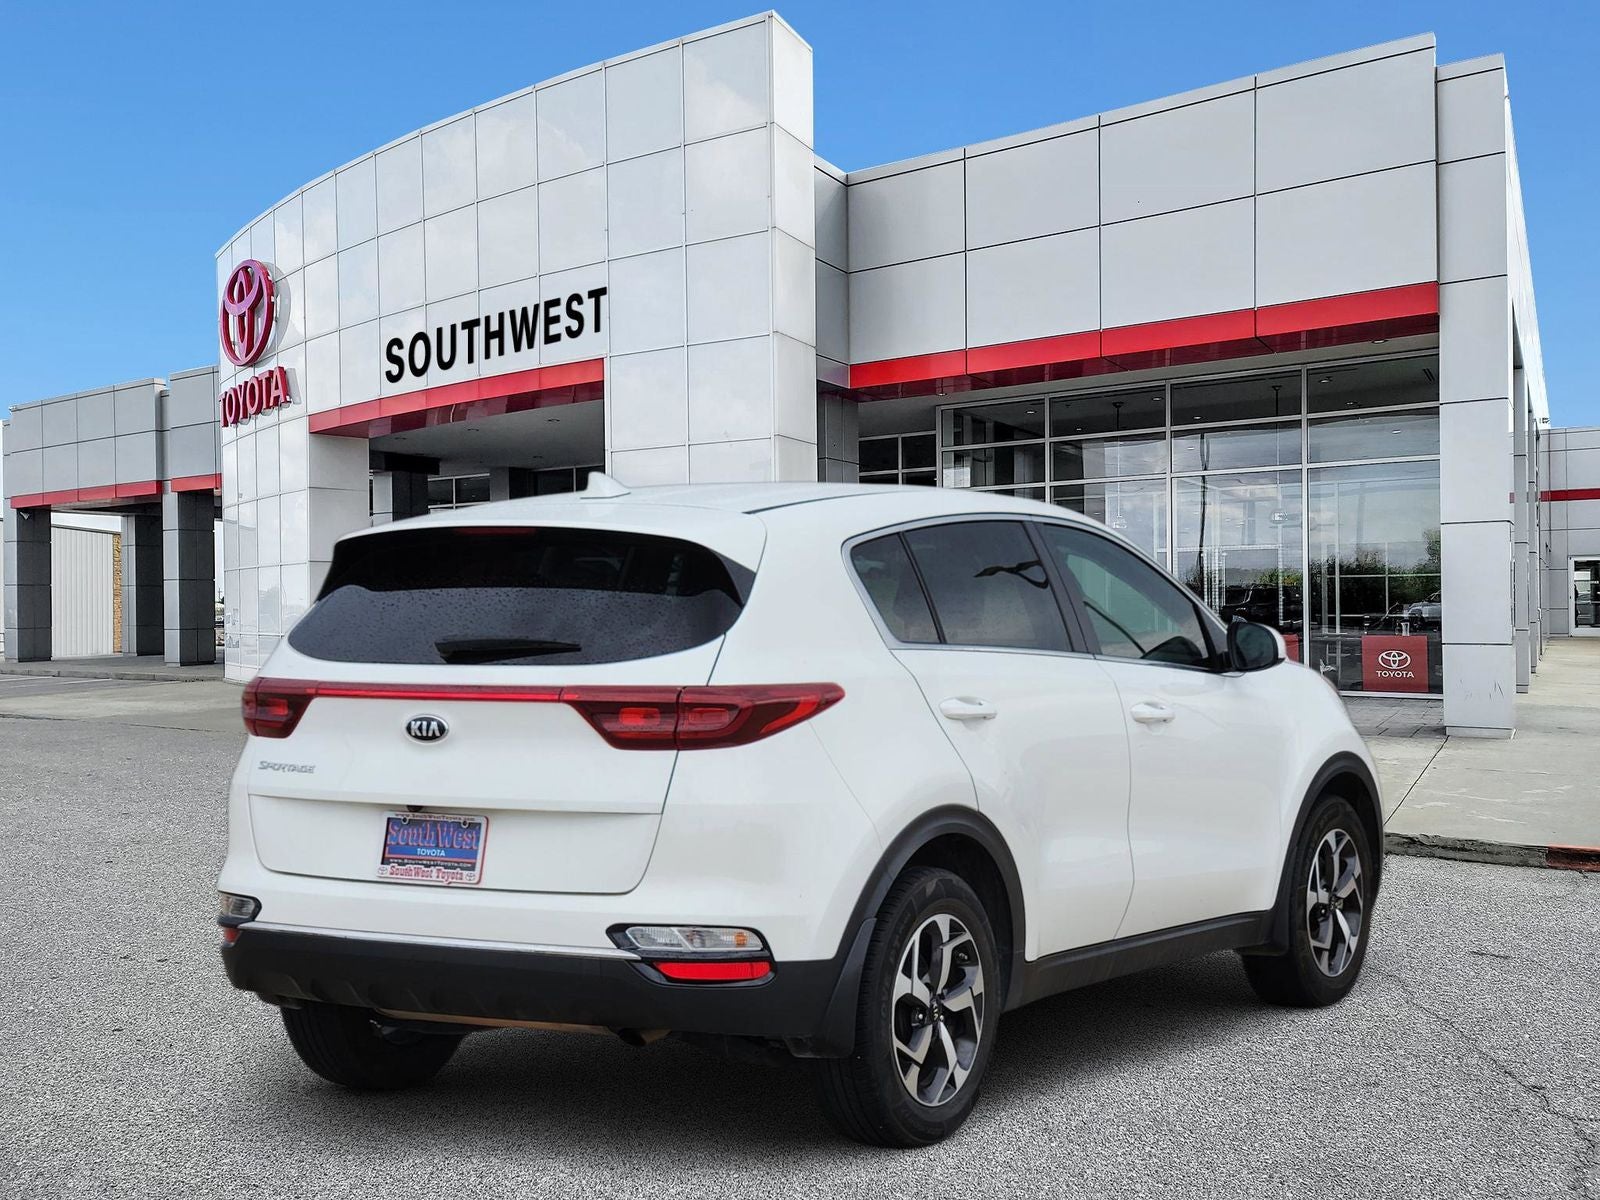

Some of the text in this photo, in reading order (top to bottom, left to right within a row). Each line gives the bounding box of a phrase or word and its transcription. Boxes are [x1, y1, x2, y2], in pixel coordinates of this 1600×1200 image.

[385, 287, 607, 383] SOUTHWEST
[219, 366, 291, 427] TOYOTA
[410, 721, 441, 737] KIA
[258, 760, 316, 774] SPORTAGE
[417, 848, 446, 857] TOYOTA
[435, 868, 464, 882] Toyota
